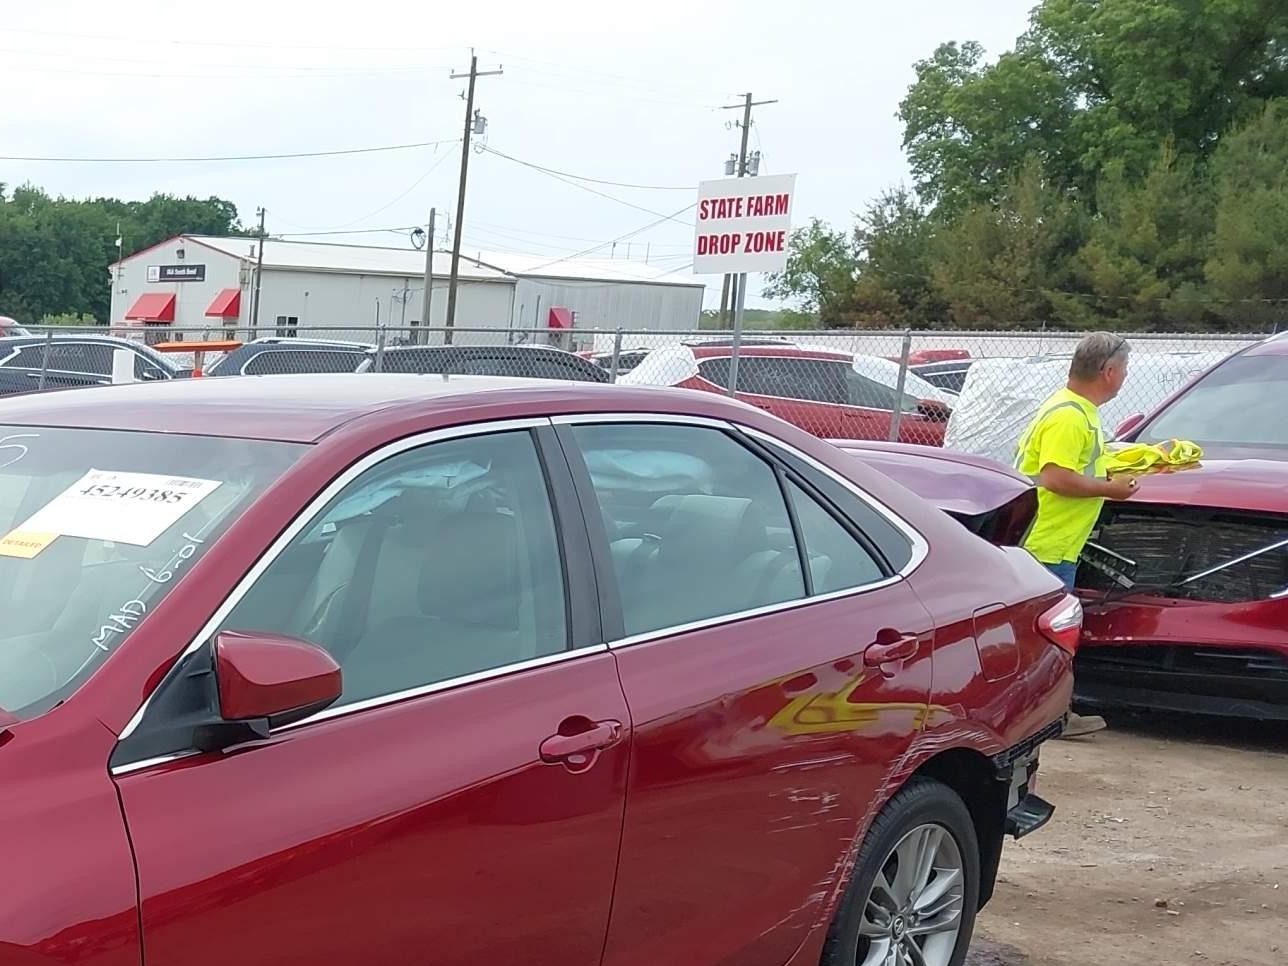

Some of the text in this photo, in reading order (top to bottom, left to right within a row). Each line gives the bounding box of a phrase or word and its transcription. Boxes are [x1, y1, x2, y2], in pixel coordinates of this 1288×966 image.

[699, 193, 790, 220] STATE FARM
[696, 231, 786, 256] DROP ZONE
[79, 484, 190, 504] 45249385
[91, 599, 147, 651] MAD
